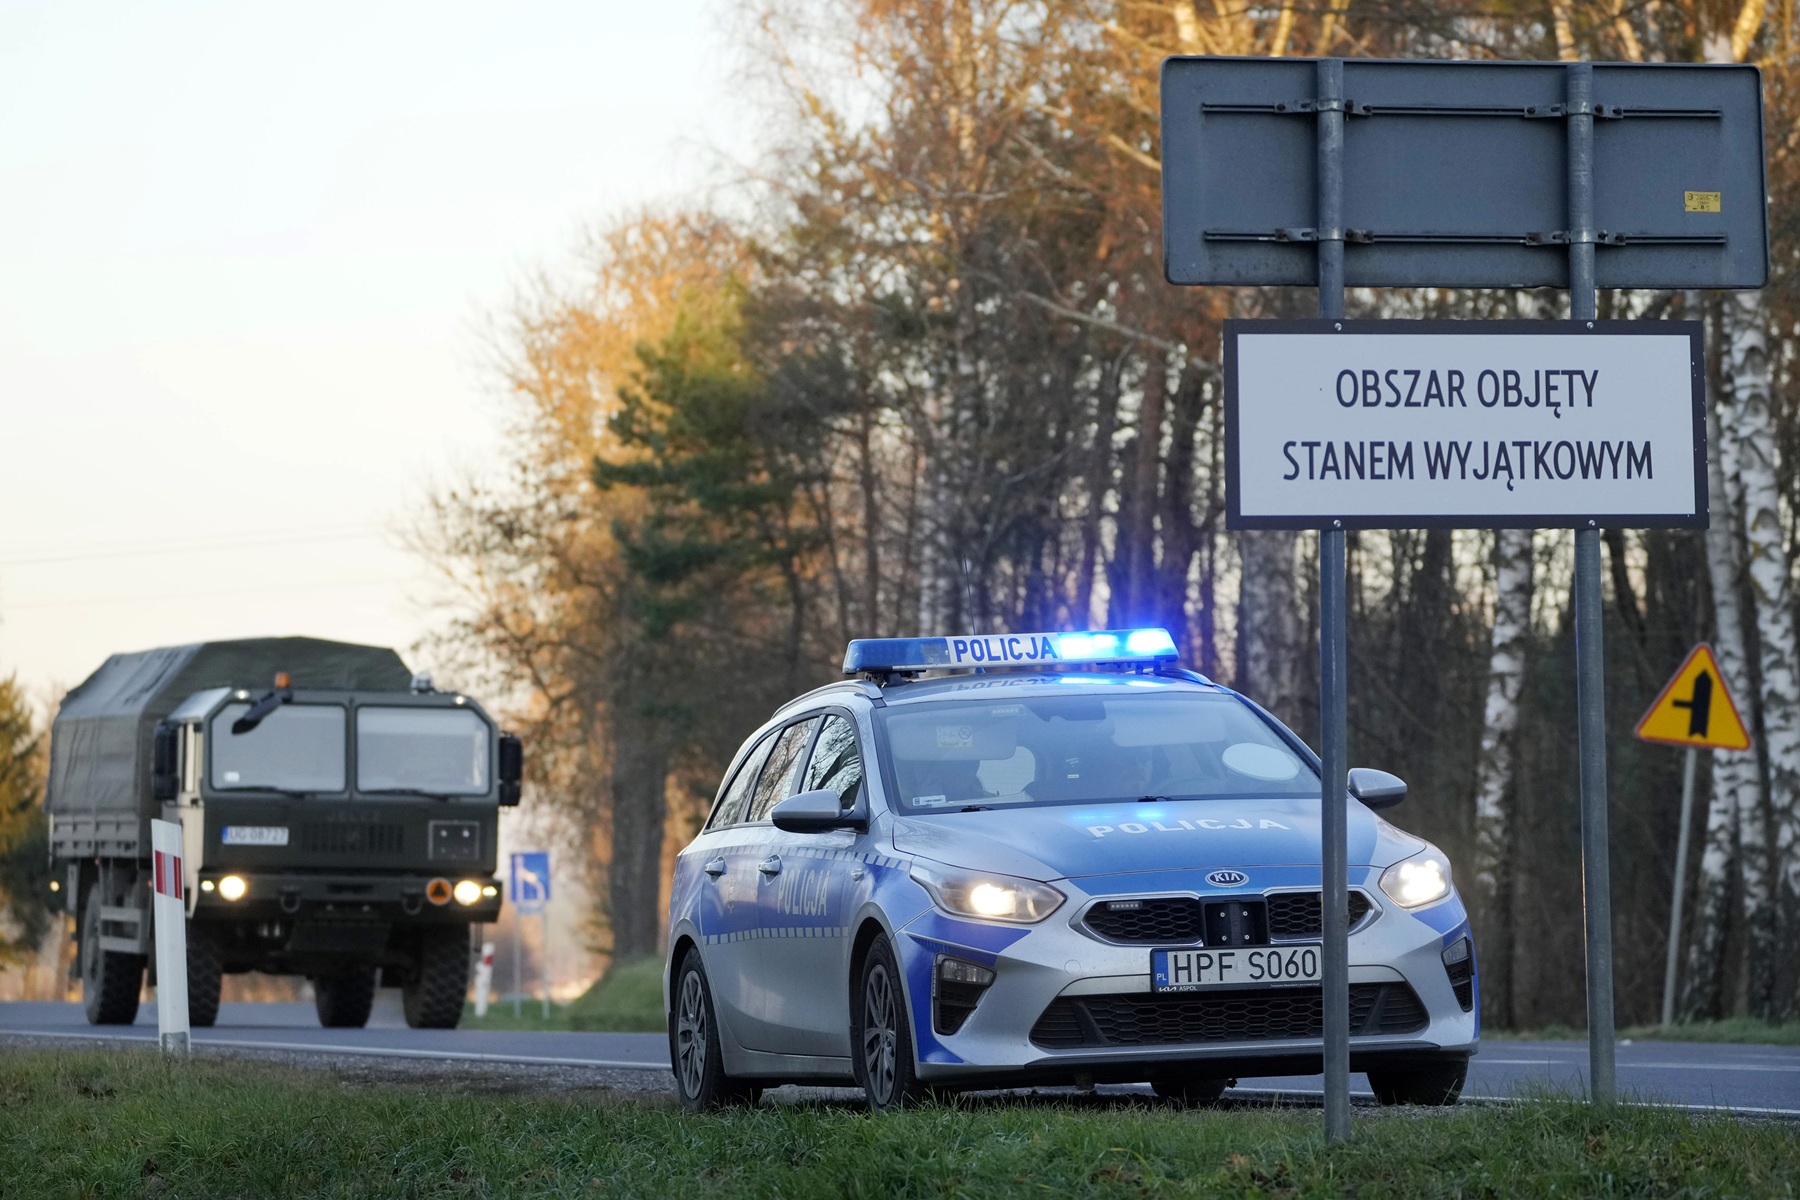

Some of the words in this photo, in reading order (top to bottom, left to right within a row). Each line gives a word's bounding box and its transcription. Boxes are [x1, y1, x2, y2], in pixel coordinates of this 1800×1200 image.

[1336, 369, 1467, 408] OBSZAR
[1477, 369, 1599, 418] OBJĘTY
[1283, 440, 1415, 481] STANEM
[1424, 440, 1654, 492] WYJĄTKOWYM
[953, 637, 1058, 661] POLICJA
[1086, 818, 1291, 838] POLICJA
[1213, 872, 1241, 882] KIA
[777, 869, 831, 917] POLICJA
[1156, 973, 1167, 981] PL
[1173, 952, 1236, 983] HPF
[1248, 949, 1317, 980] S060
